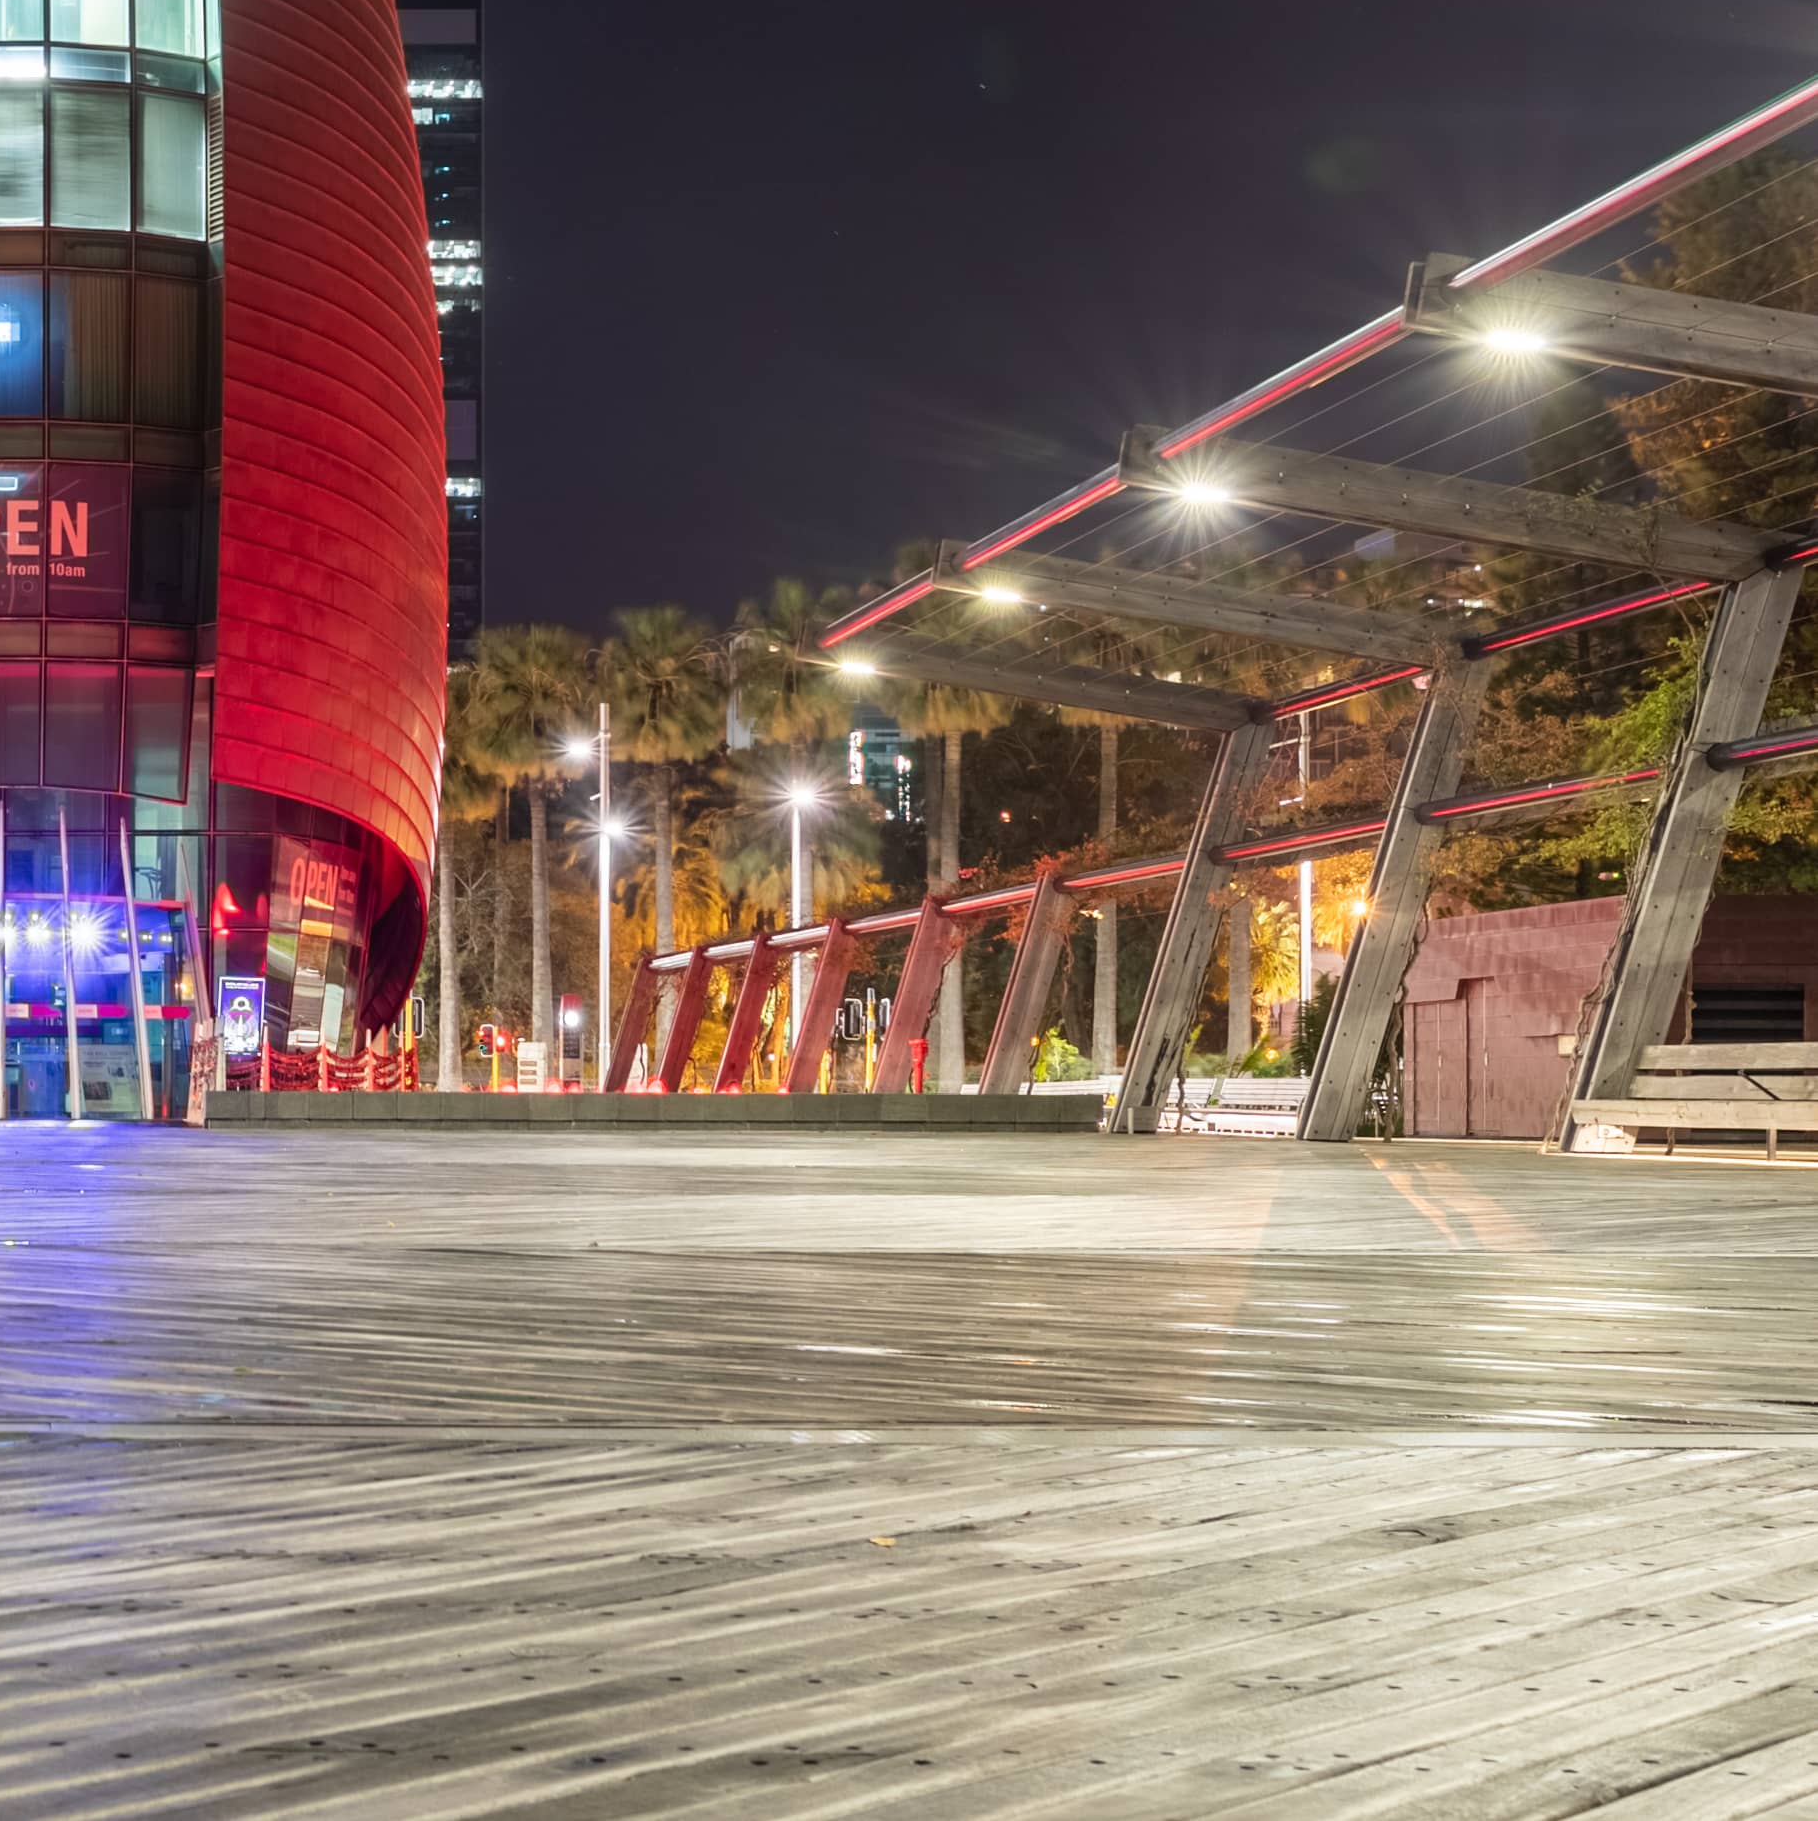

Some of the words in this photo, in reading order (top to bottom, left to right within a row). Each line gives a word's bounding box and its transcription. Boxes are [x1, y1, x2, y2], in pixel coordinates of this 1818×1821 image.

[6, 562, 40, 576] from
[49, 563, 86, 578] 10am
[290, 858, 339, 907] OPEN
